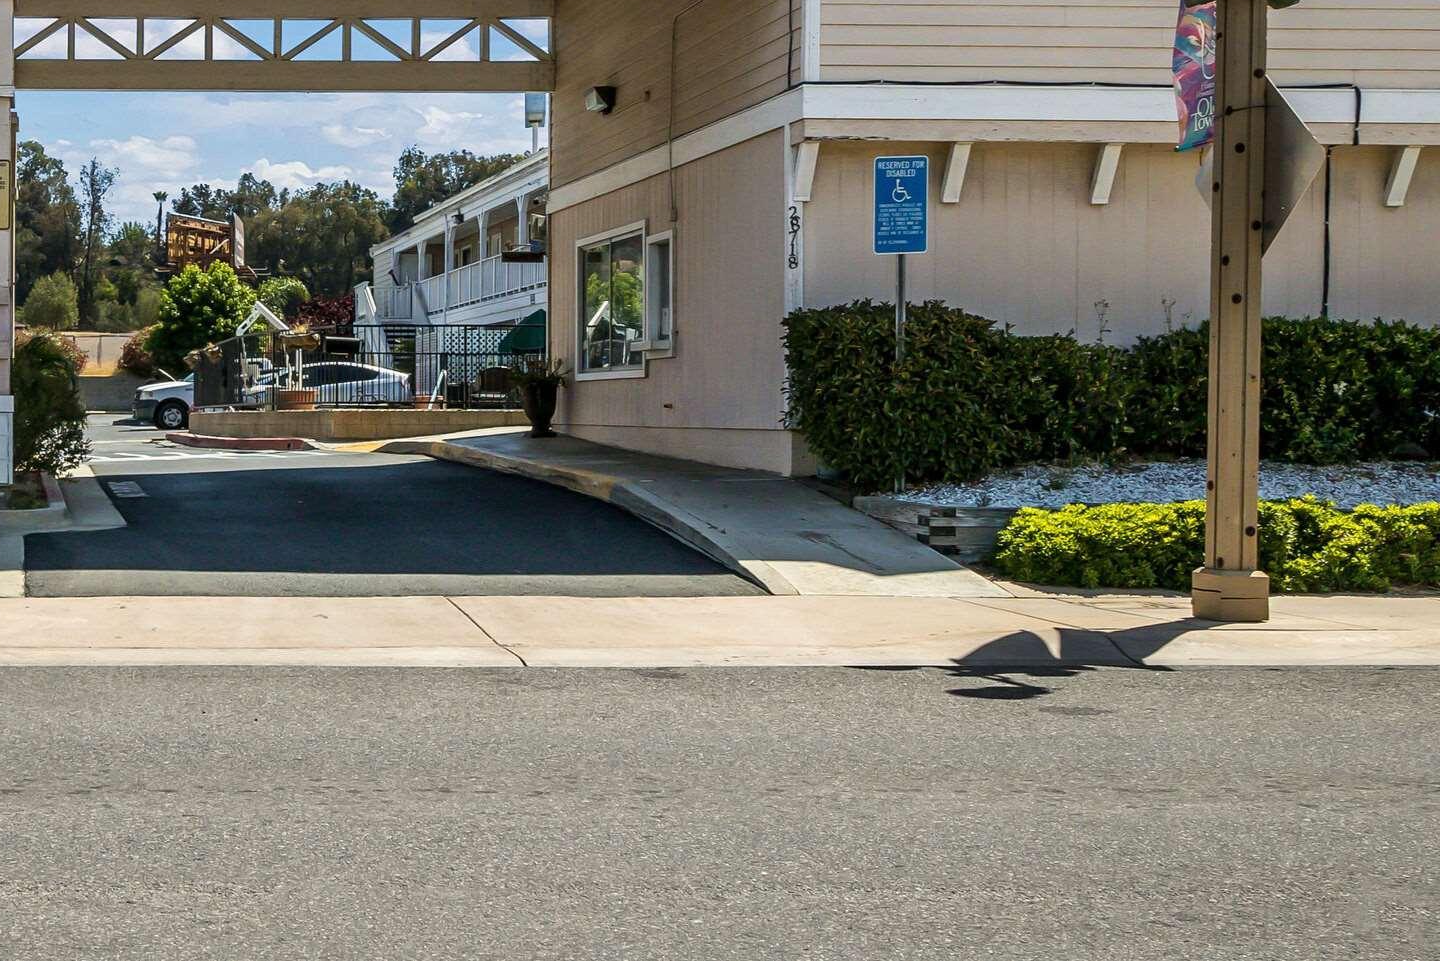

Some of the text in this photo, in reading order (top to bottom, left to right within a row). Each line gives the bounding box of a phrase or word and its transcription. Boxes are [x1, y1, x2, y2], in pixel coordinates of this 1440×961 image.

[1191, 112, 1216, 131] Tow
[877, 160, 926, 169] RESERVED FOR
[885, 169, 916, 177] DISABLED
[788, 205, 801, 270] 28718
